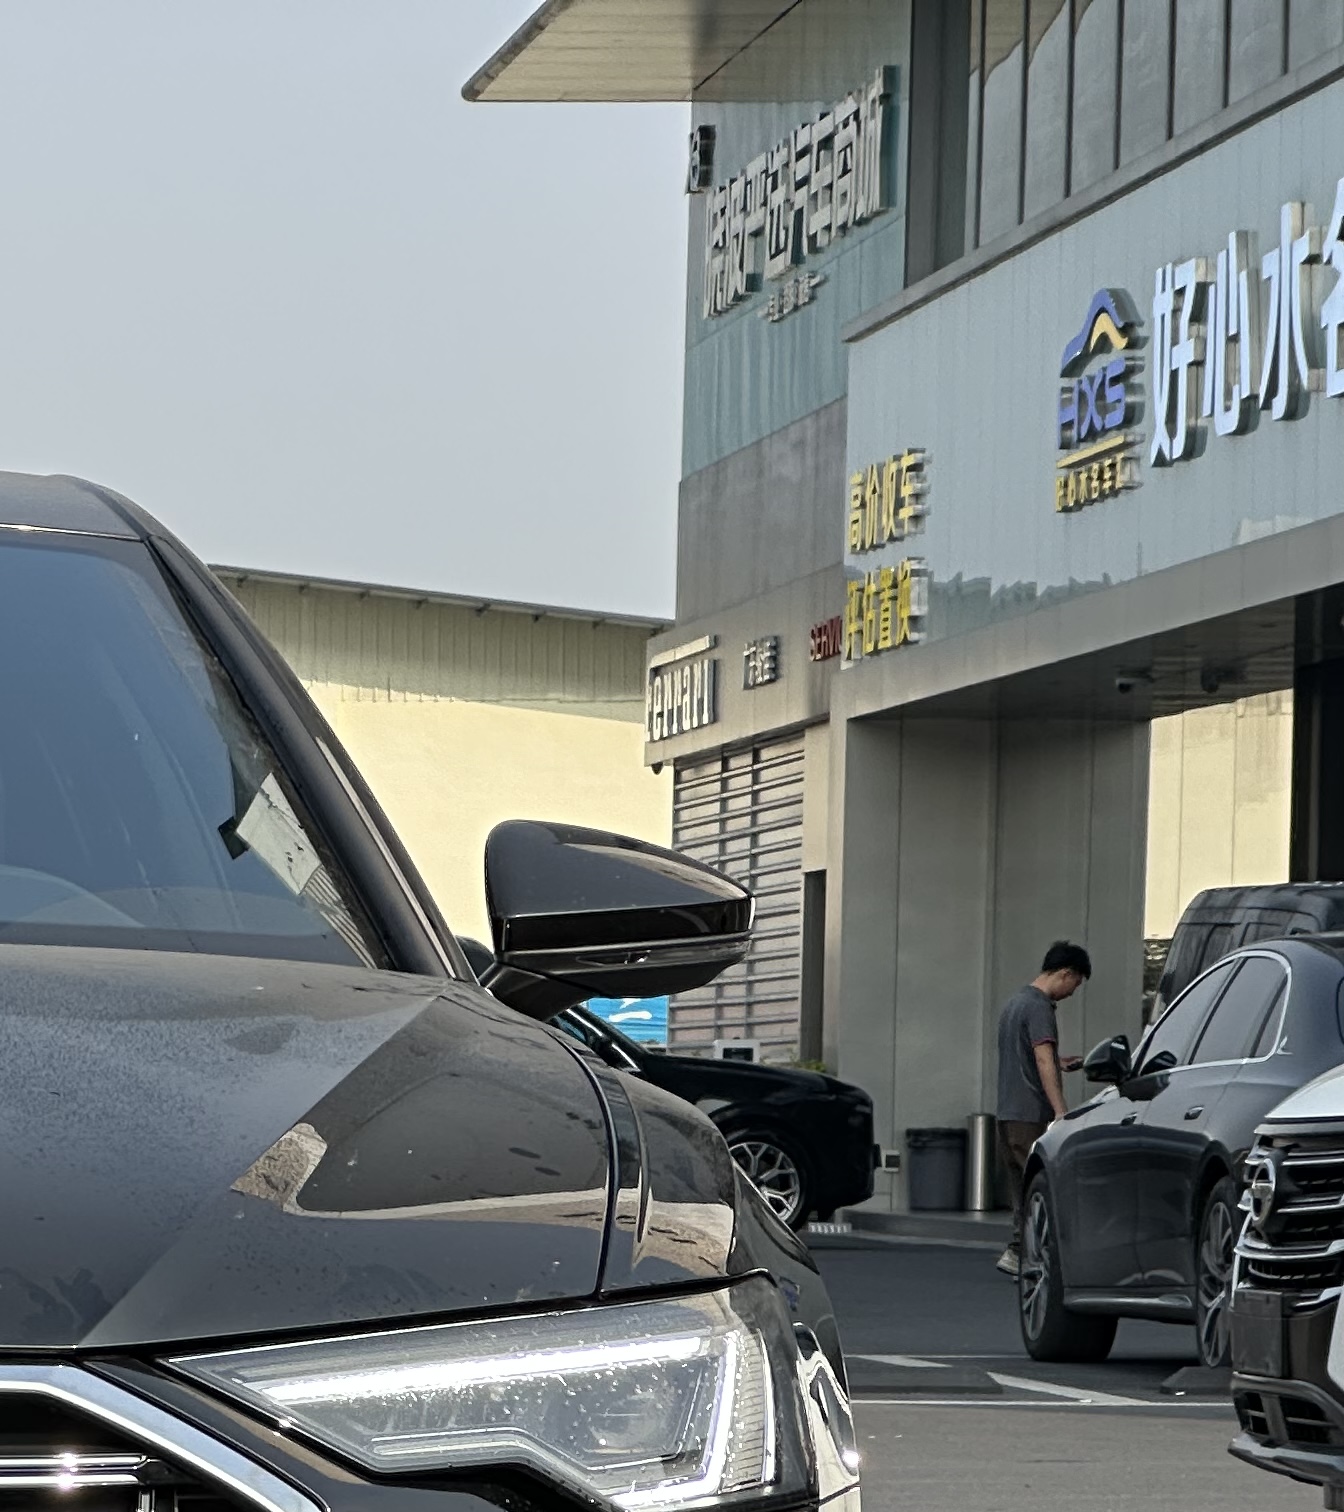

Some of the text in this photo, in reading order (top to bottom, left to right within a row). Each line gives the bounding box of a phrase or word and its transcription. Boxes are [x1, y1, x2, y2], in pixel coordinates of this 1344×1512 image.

[1058, 357, 1126, 450] HXS
[849, 449, 920, 552] 高价收车
